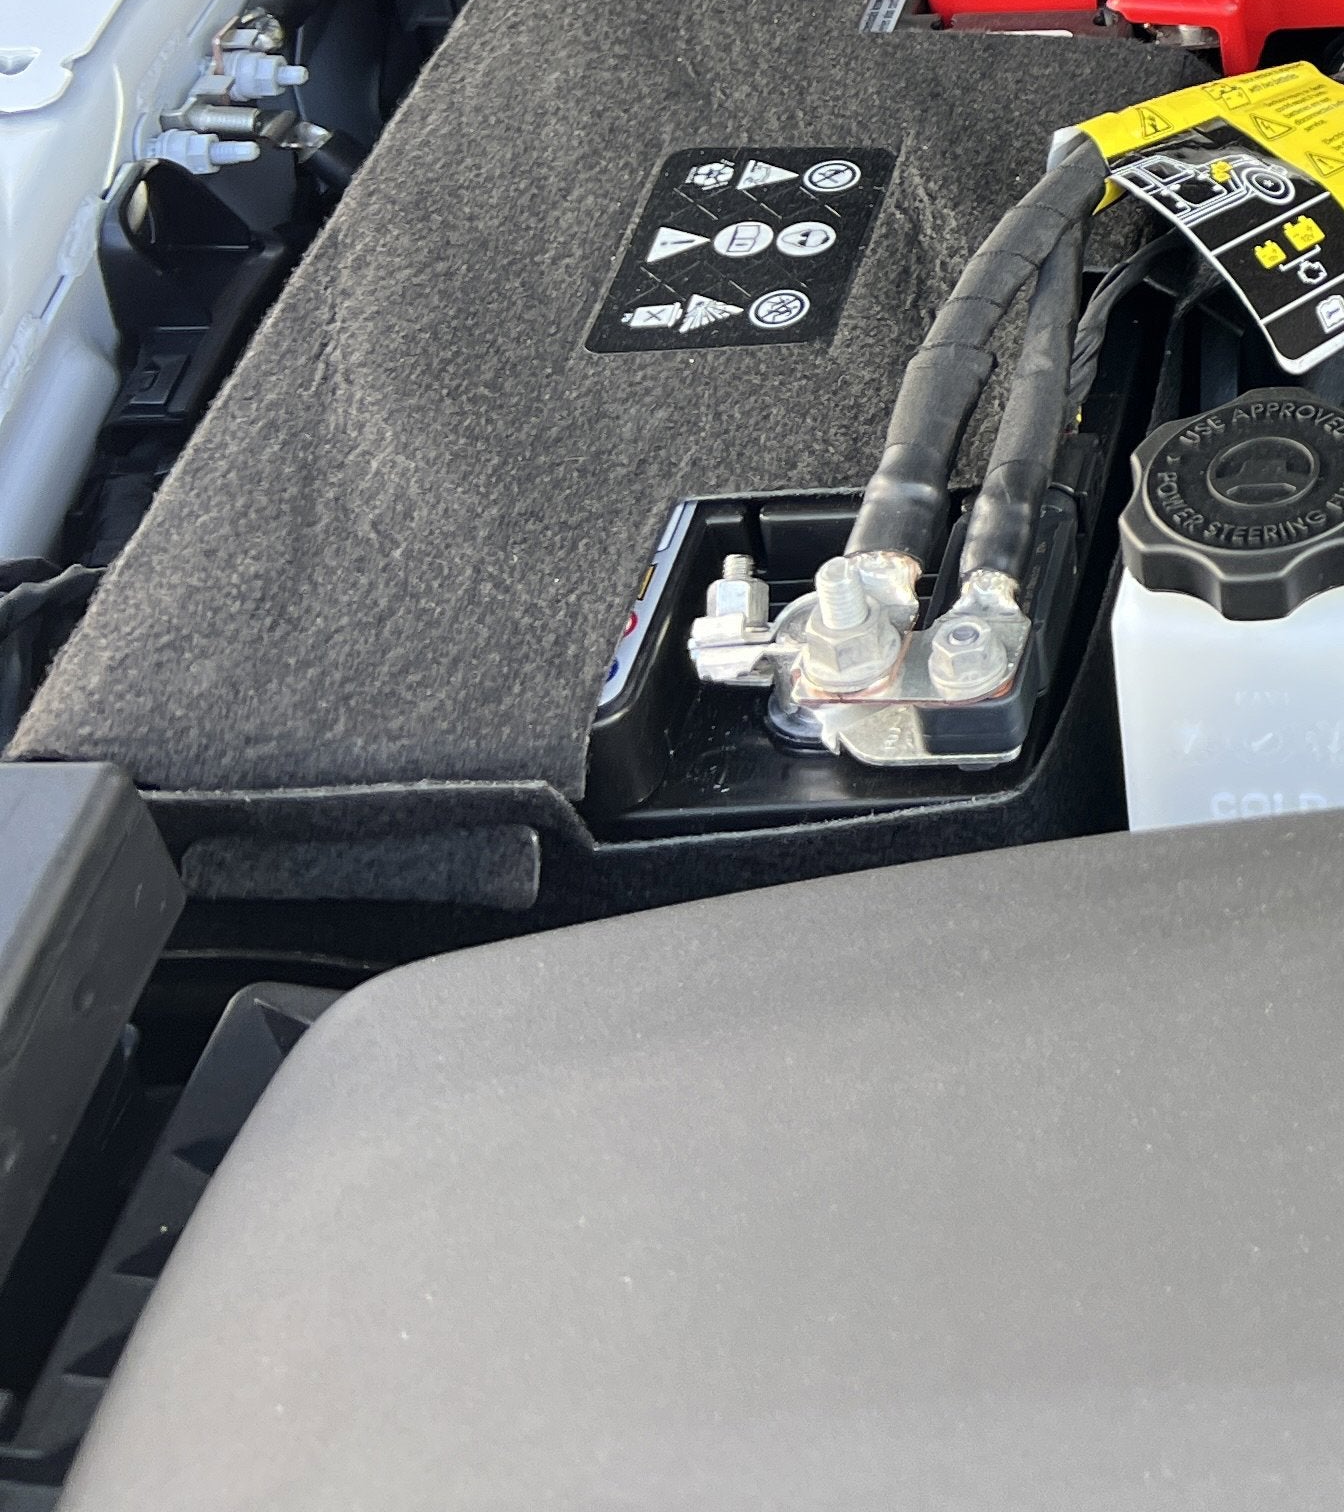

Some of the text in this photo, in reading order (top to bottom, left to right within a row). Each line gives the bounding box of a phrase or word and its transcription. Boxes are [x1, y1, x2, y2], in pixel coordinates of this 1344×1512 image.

[1180, 415, 1226, 447] USE
[1157, 471, 1205, 534] POWER
[1204, 510, 1328, 544] STEERING
